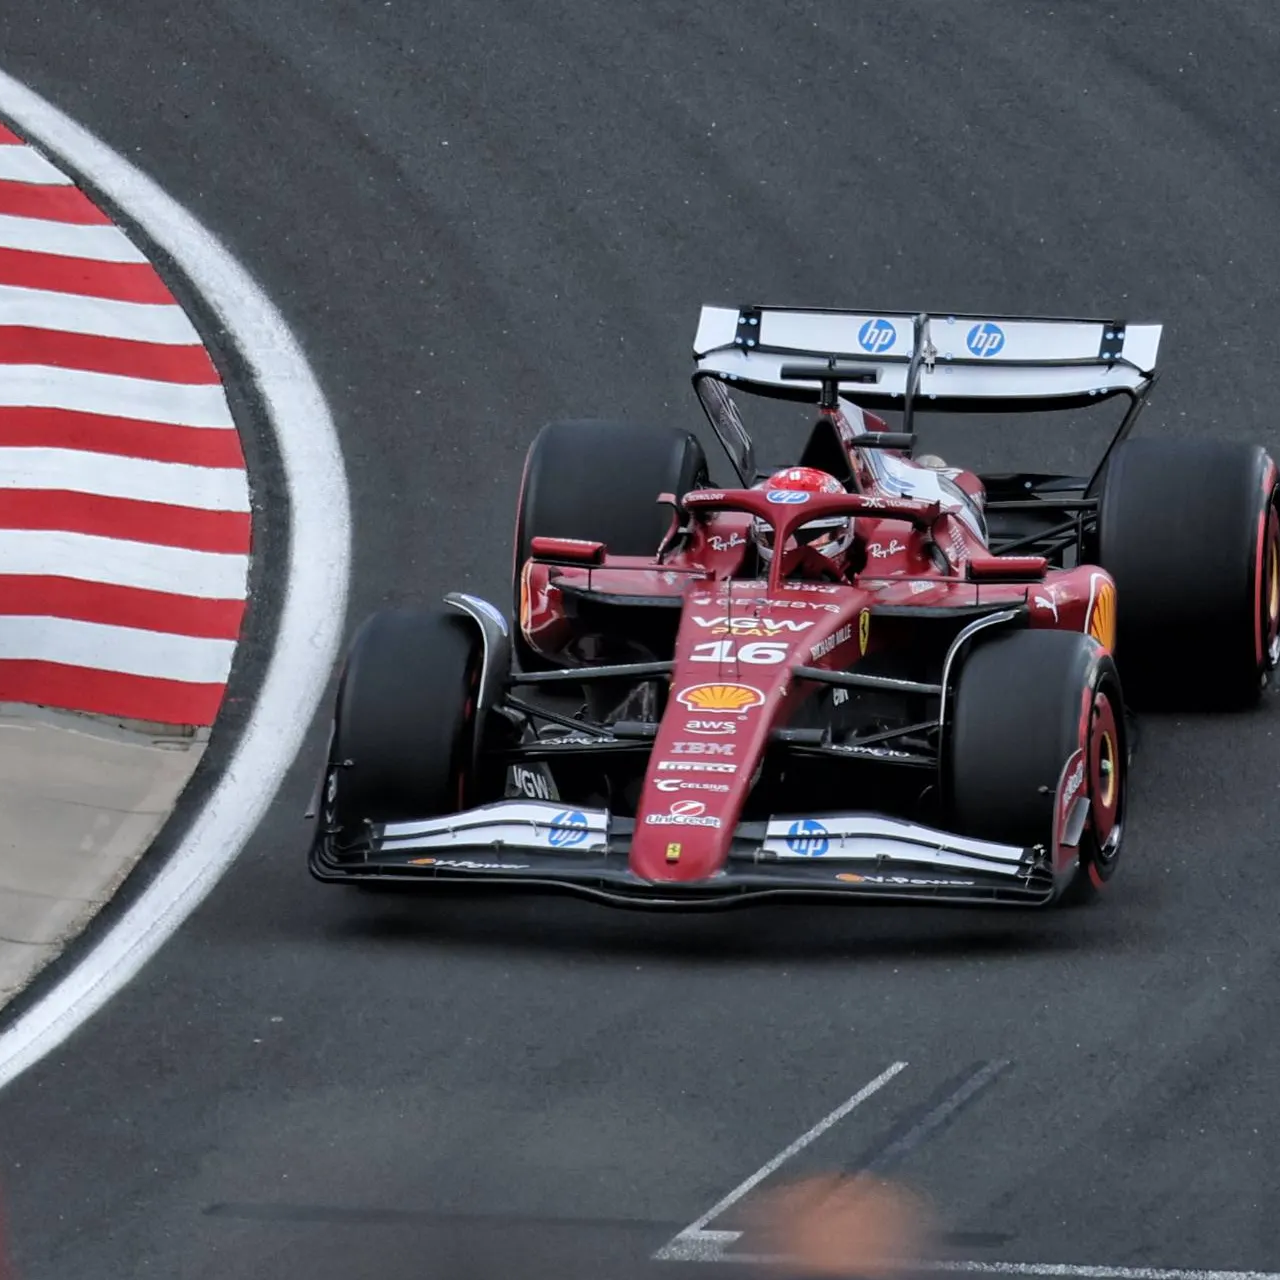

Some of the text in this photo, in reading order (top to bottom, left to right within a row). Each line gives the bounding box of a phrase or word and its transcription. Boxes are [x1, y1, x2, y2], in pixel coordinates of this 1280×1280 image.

[861, 319, 894, 352] hp
[970, 323, 1002, 357] hp
[707, 533, 746, 551] Ray-Ban
[867, 540, 906, 558] Ray-Ban
[716, 598, 840, 613] GENESYS
[691, 616, 816, 631] VGW
[711, 627, 783, 637] PLAY
[689, 640, 789, 665] 16
[686, 719, 736, 731] aws
[671, 742, 737, 756] IBM
[657, 761, 738, 773] PIRELLI
[513, 765, 549, 800] VGW
[680, 783, 730, 792] CELSIUS
[551, 812, 586, 846] hp
[646, 814, 722, 828] UniCredit
[790, 820, 824, 856] hp
